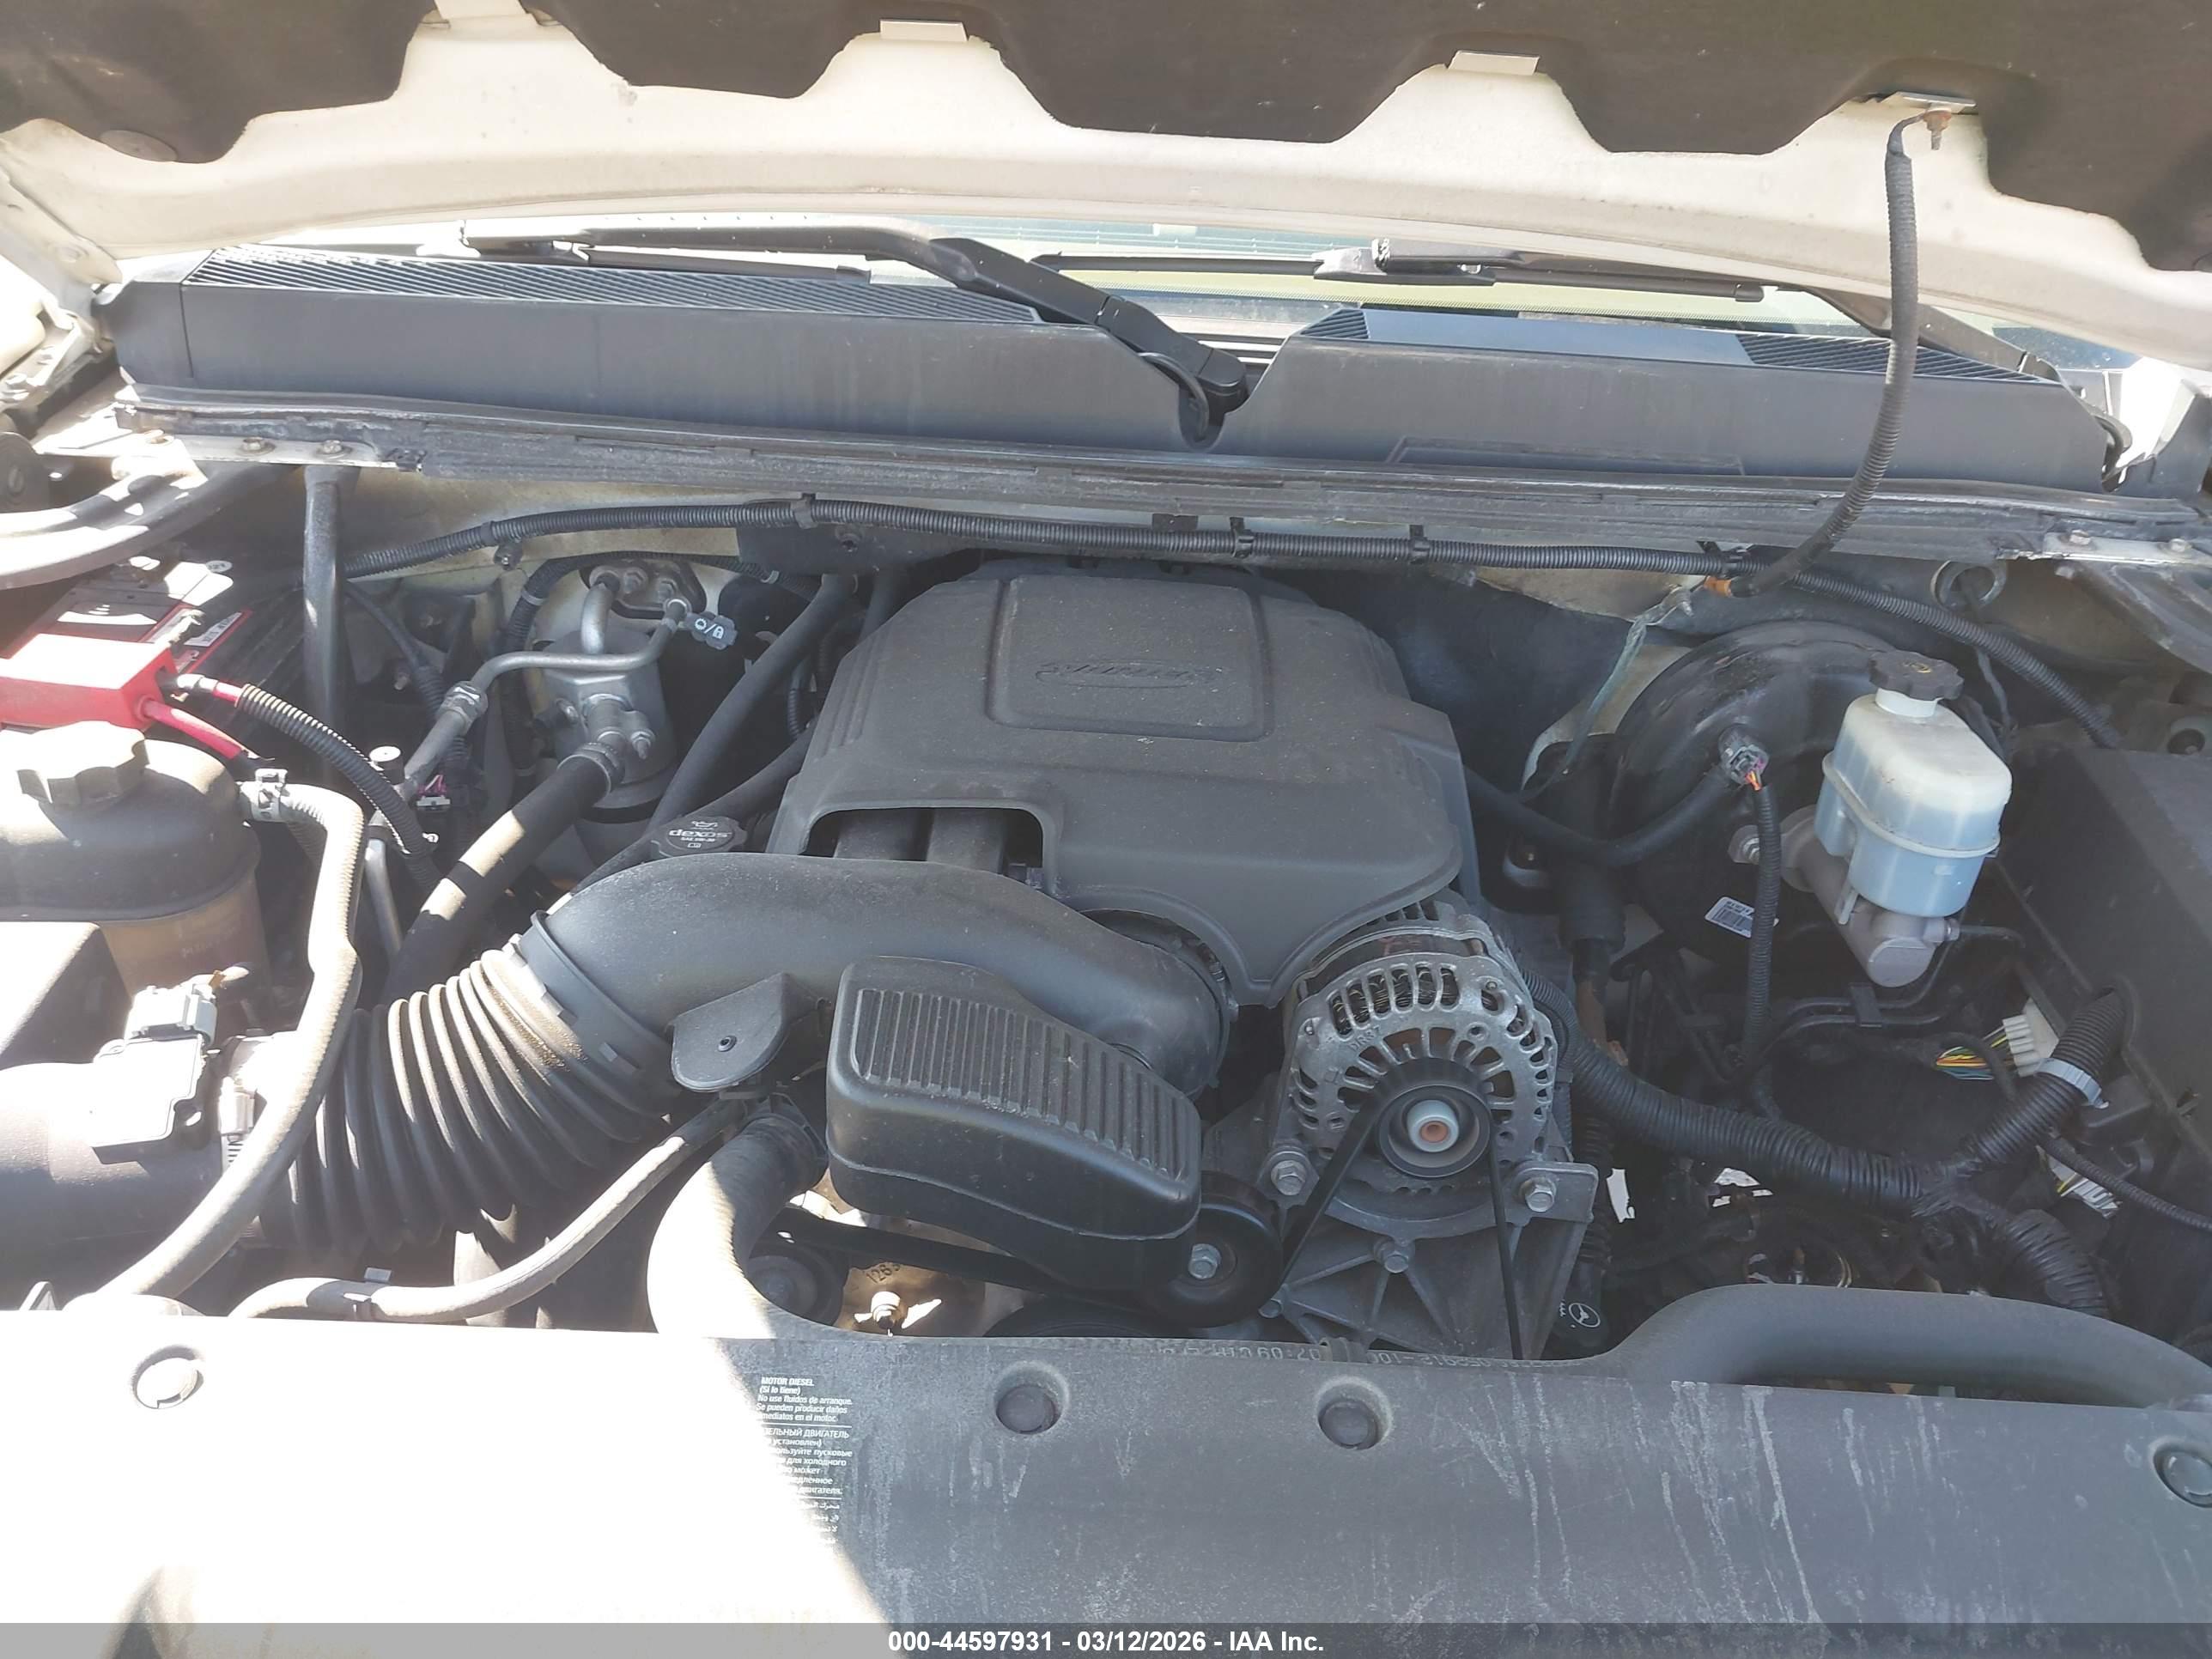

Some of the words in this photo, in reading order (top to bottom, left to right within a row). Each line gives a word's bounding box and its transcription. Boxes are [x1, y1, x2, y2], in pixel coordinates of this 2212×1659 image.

[668, 829, 732, 838] dexos
[761, 1376, 787, 1385] MOTOR
[788, 1378, 815, 1387] DIESEL
[779, 1386, 801, 1395] tiene)
[819, 1398, 854, 1407] arranque.
[767, 1403, 793, 1413] pueden
[803, 1429, 850, 1438] ДВИГАТЕЛЬ
